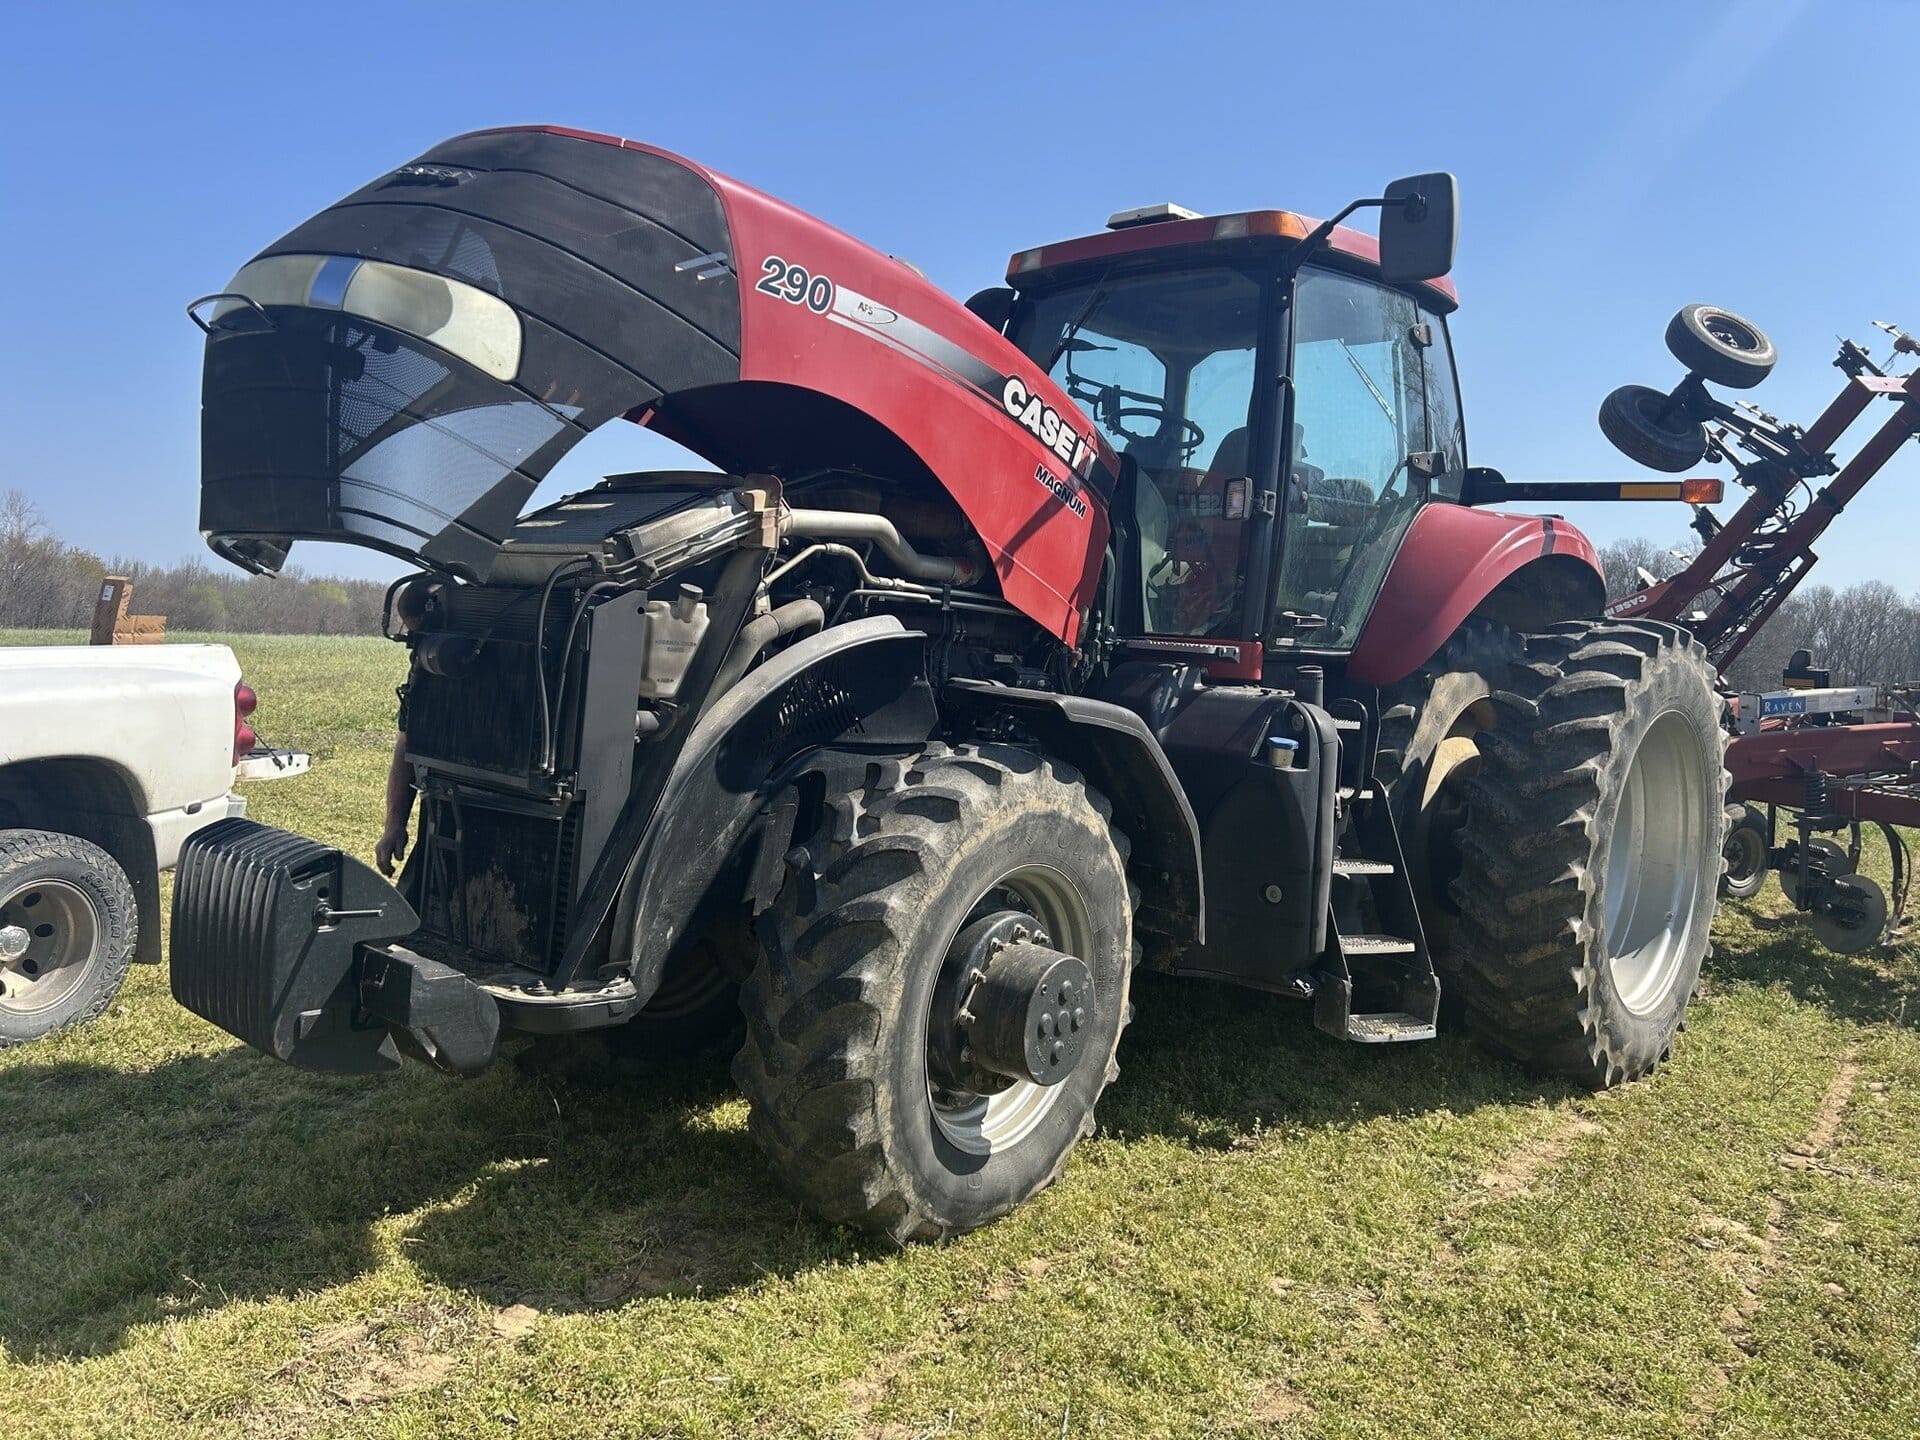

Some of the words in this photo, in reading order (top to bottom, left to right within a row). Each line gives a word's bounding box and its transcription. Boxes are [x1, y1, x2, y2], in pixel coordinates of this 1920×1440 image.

[755, 256, 833, 314] 290
[858, 301, 873, 316] AFS
[1034, 463, 1087, 519] MAGNUM
[1764, 700, 1802, 713] RAVEN
[80, 871, 121, 939] ROADIAN
